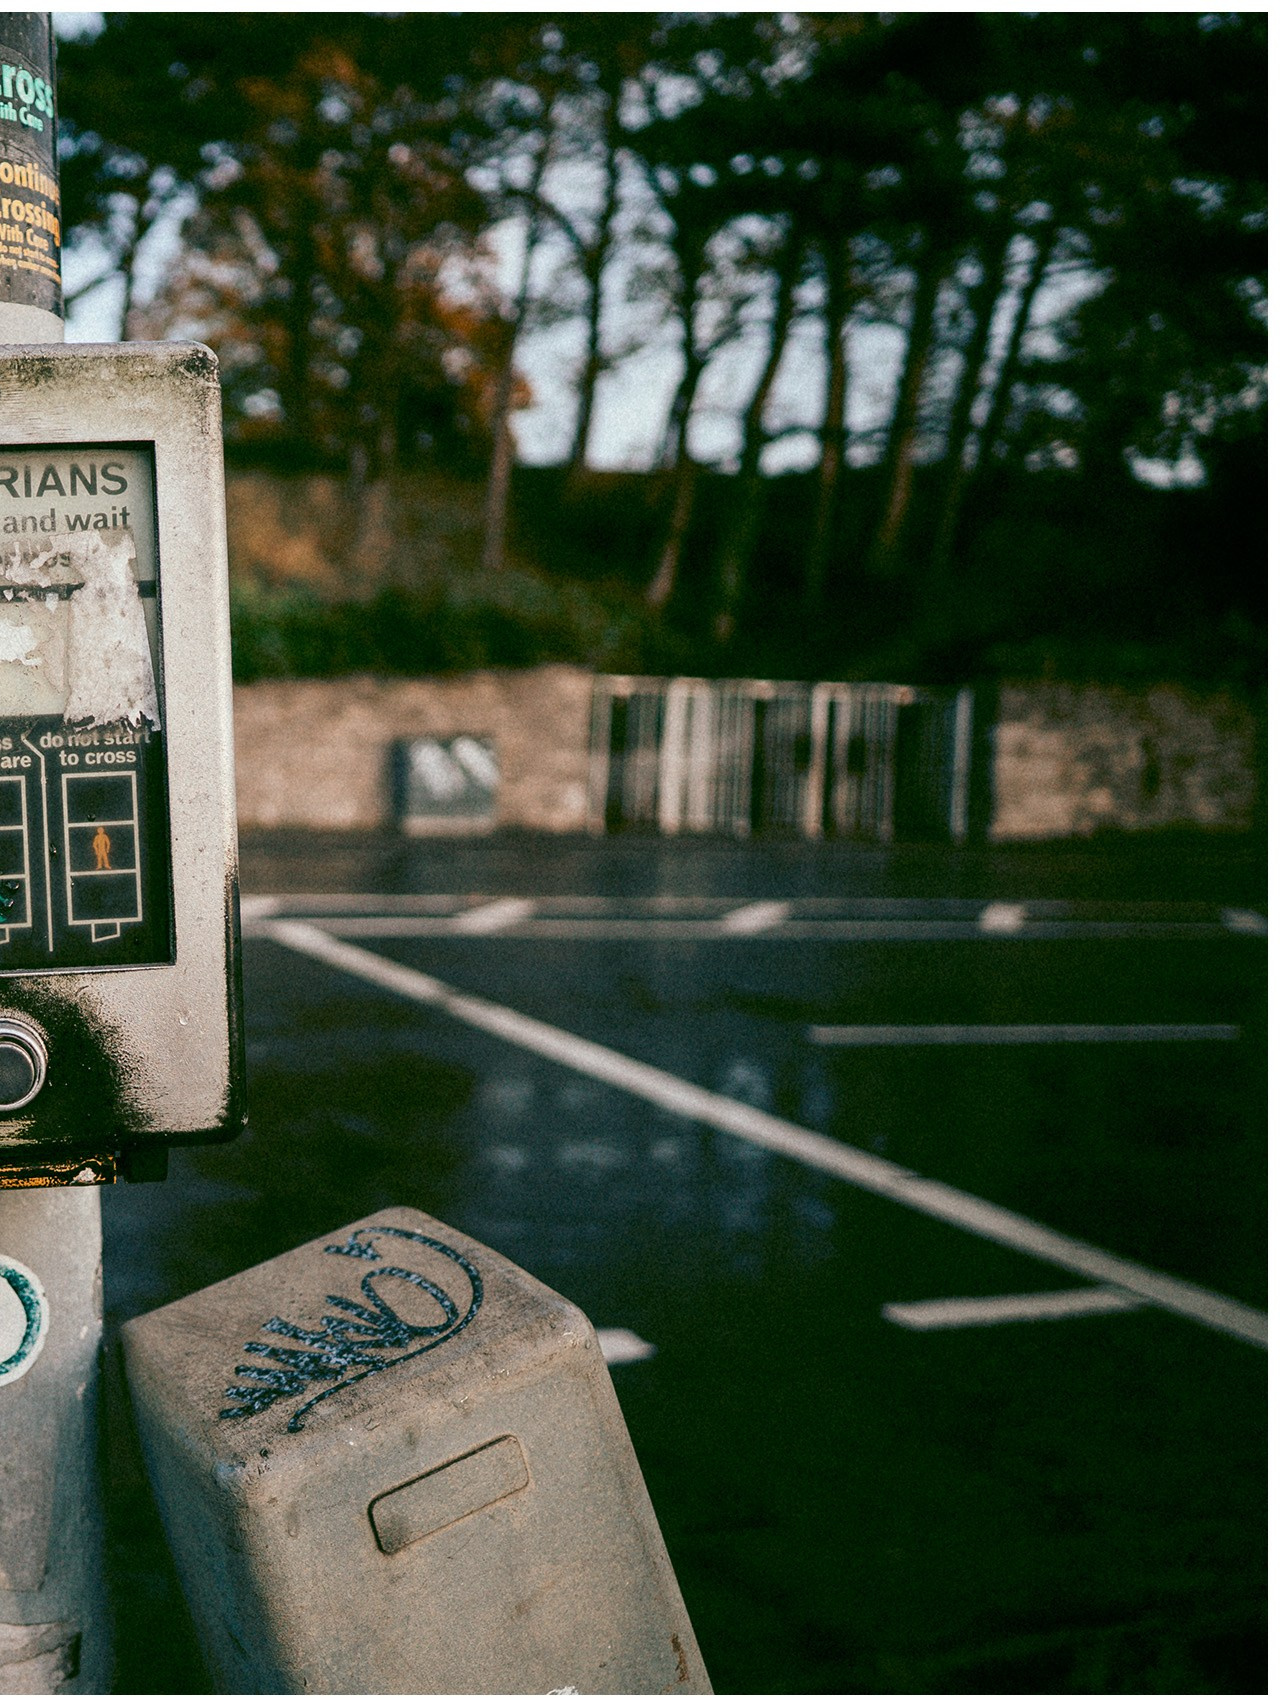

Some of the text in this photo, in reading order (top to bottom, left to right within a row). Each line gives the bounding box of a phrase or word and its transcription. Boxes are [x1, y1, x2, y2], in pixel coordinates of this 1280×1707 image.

[3, 508, 56, 534] and
[65, 506, 130, 532] wait
[39, 729, 151, 748] do not start
[59, 749, 137, 766] to cross
